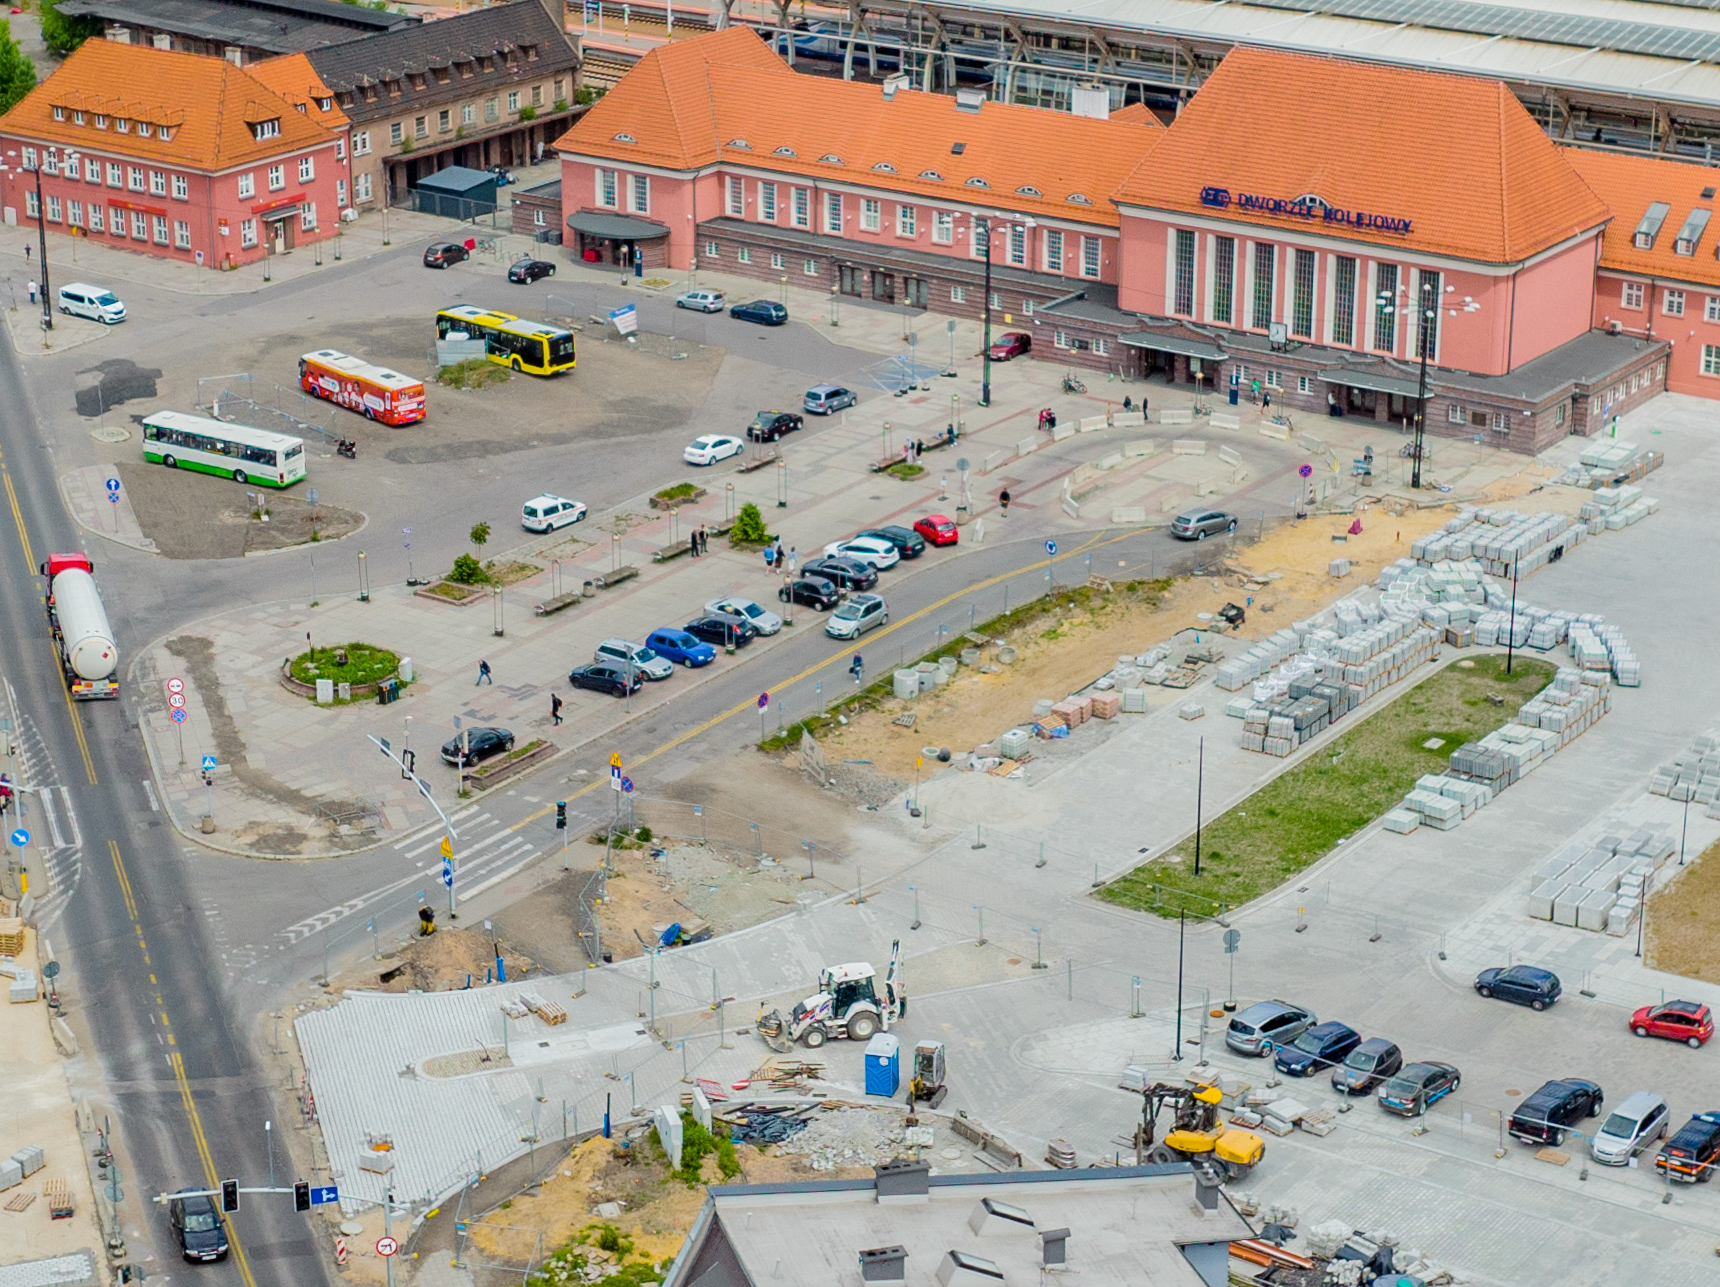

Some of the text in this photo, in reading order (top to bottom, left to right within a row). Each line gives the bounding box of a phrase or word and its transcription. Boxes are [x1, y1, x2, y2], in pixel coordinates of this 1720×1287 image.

[1237, 193, 1316, 219] DWORZEC
[1323, 207, 1413, 233] KOLEJOWY
[172, 697, 183, 705] 30
